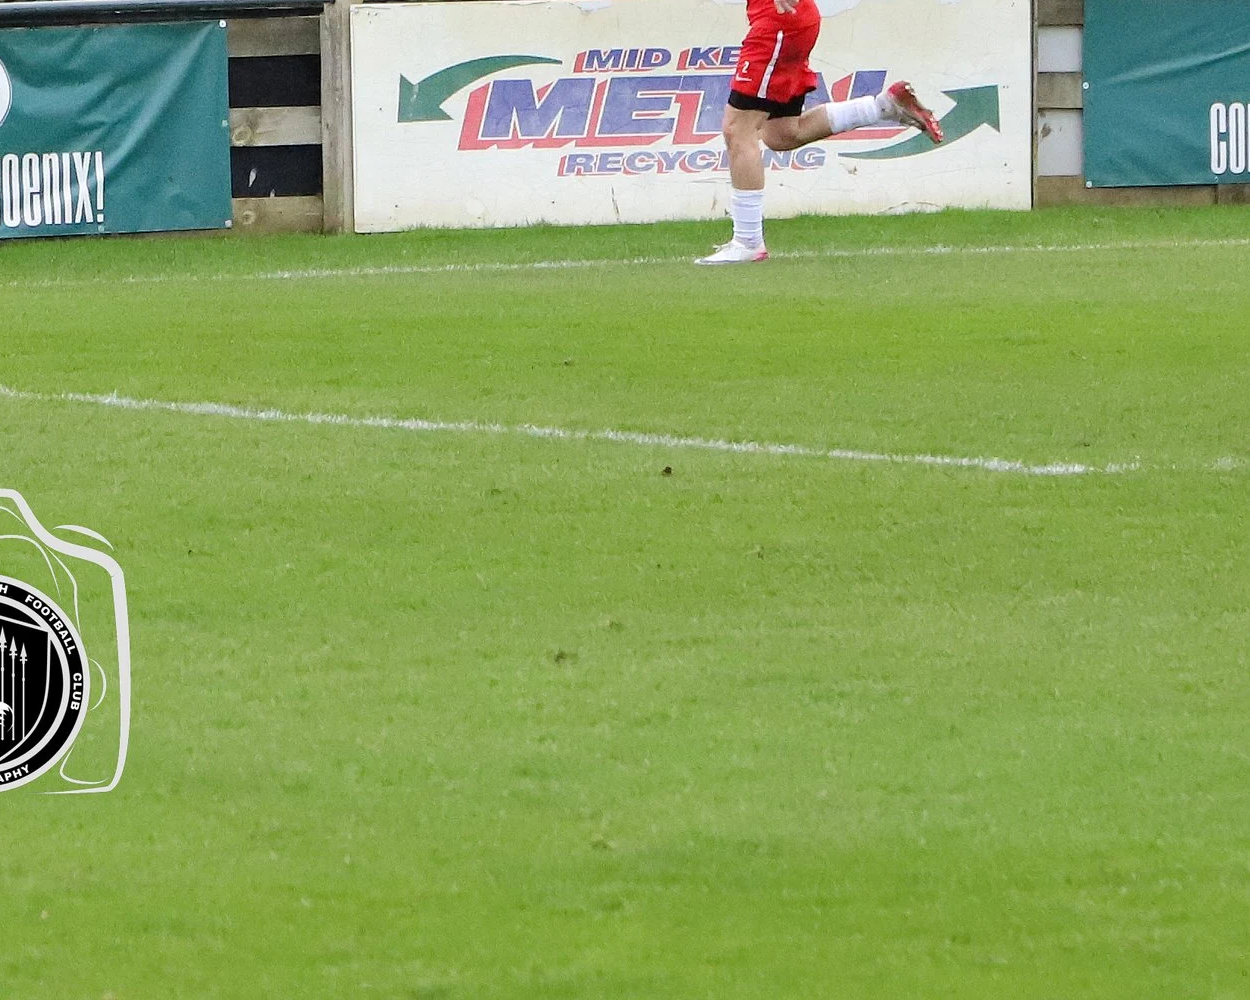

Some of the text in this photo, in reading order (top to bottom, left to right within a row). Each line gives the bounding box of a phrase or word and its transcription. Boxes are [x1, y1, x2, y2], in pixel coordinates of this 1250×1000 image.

[573, 47, 672, 73] MID
[457, 70, 908, 151] METL
[557, 146, 827, 178] RECYCNG
[1210, 102, 1250, 175] CO
